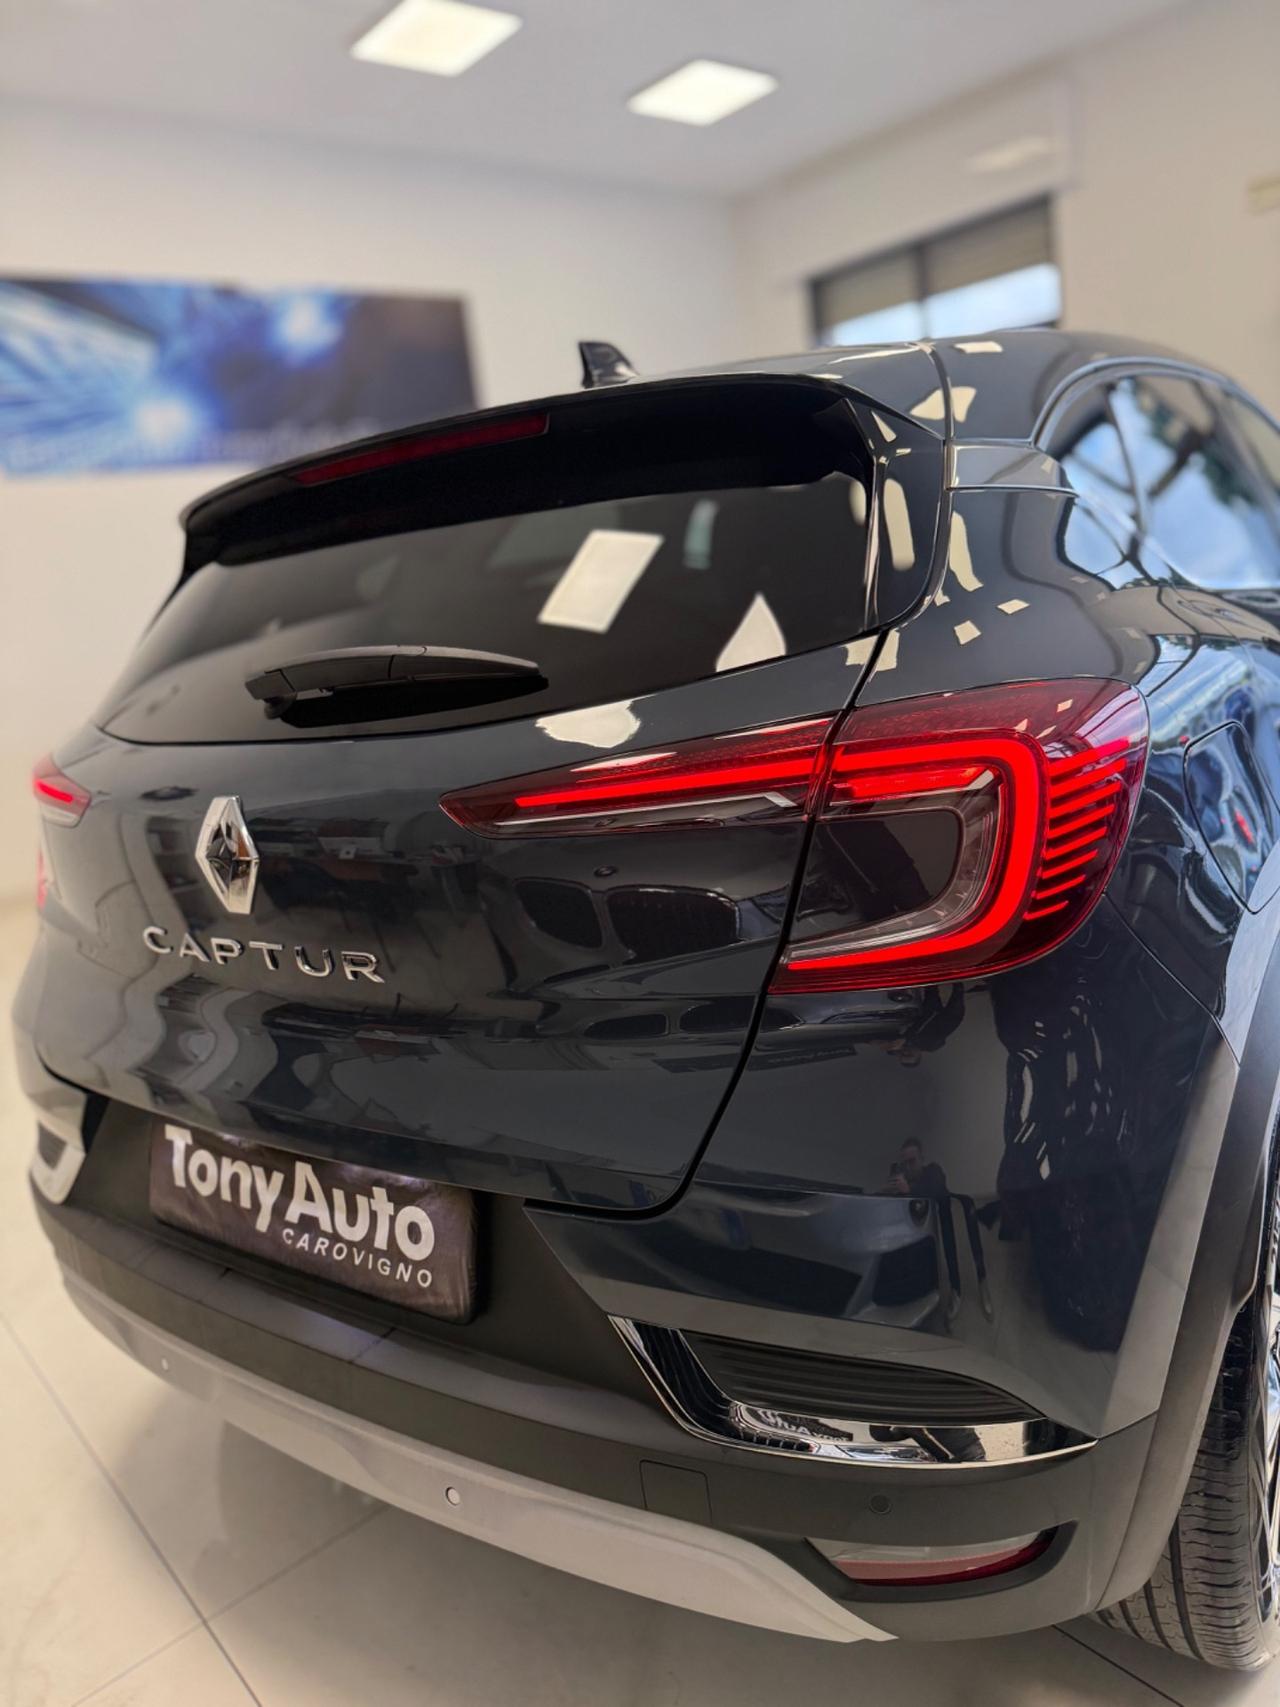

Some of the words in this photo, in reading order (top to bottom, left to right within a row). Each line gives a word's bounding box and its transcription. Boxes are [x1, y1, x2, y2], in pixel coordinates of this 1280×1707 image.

[143, 926, 385, 983] CAPTUR
[164, 1124, 285, 1233] Tony
[285, 1160, 435, 1261] Auto
[282, 1228, 432, 1288] CAROVIGNO
